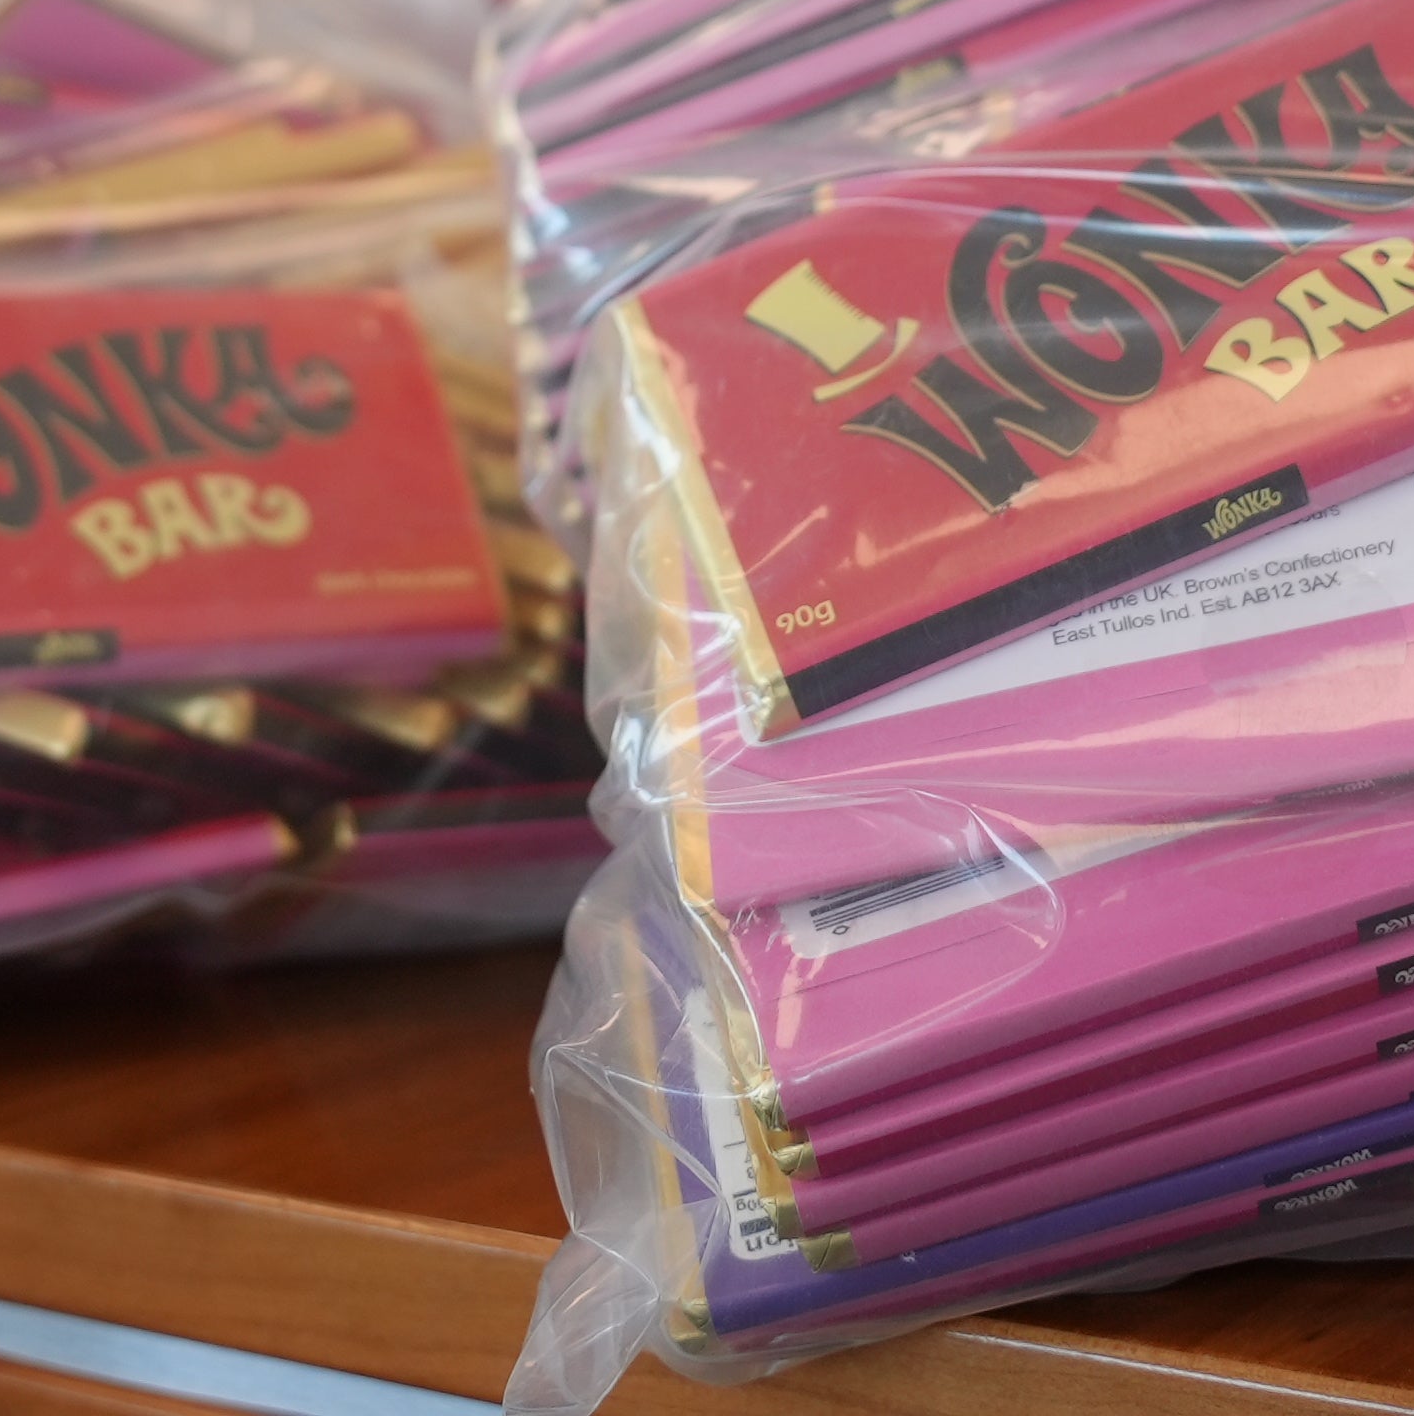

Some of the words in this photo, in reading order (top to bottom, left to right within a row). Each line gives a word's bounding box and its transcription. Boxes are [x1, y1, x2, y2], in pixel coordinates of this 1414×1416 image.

[71, 472, 312, 580] BAR
[1201, 486, 1283, 540] WONKA
[1185, 567, 1260, 595] Brown's
[1264, 539, 1396, 578] Confectionery
[775, 599, 836, 634] 90g
[1052, 624, 1096, 646] East
[1099, 615, 1155, 635] Tullos
[1160, 603, 1193, 624] Ind.
[1241, 583, 1294, 608] AB12
[1274, 1179, 1359, 1212] WONKA
